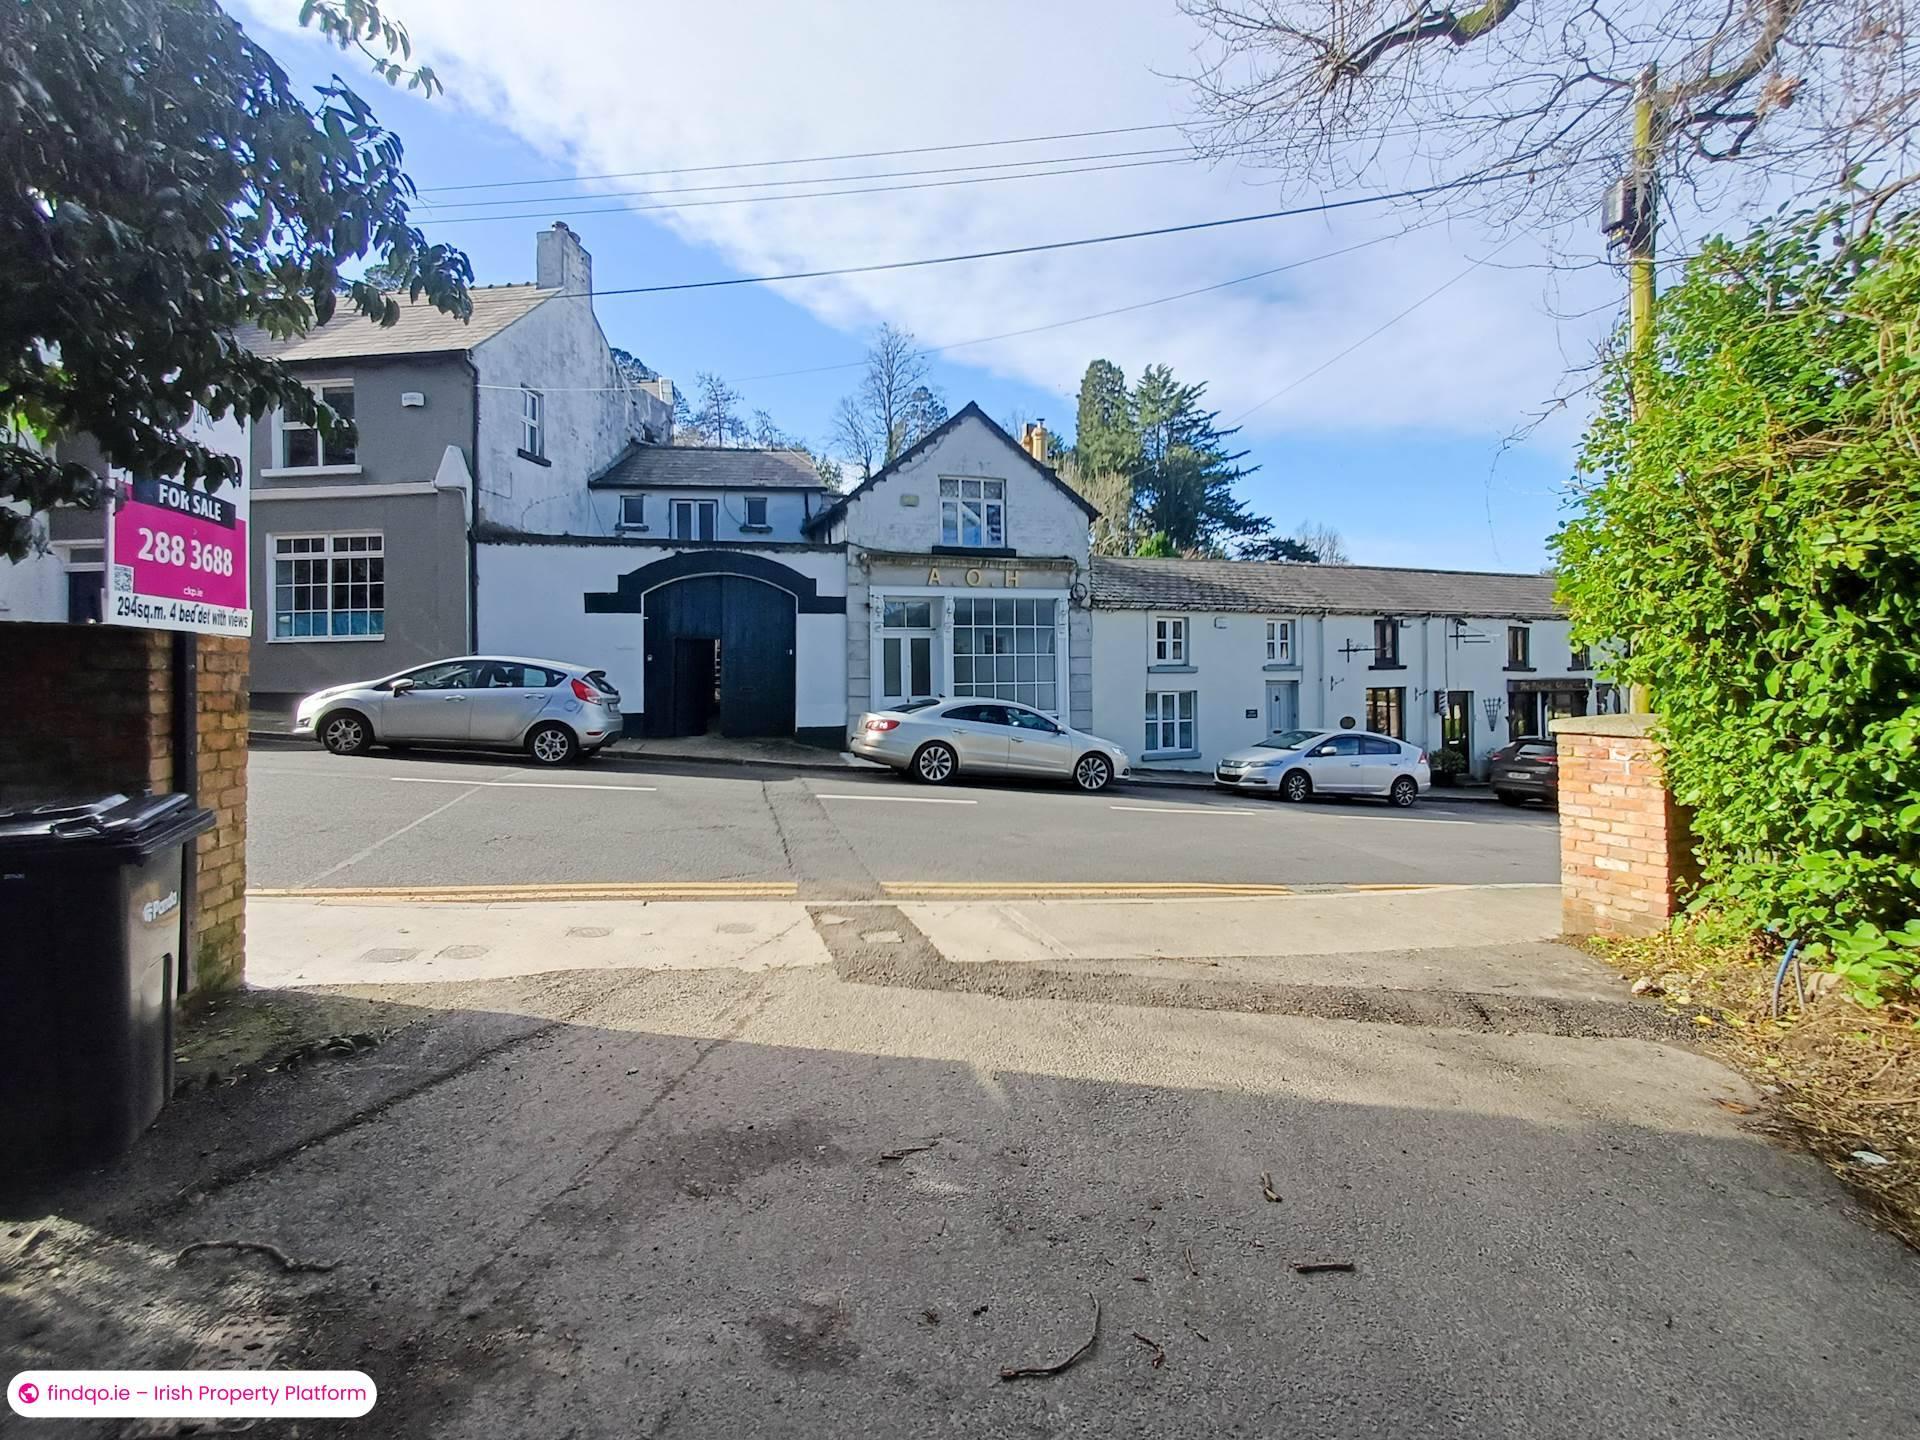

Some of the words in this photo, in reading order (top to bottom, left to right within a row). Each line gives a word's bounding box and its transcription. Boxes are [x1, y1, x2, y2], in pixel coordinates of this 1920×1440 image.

[159, 484, 190, 511] FOR
[192, 495, 222, 521] SALE
[138, 527, 186, 567] 288
[190, 539, 233, 577] 3688
[117, 596, 166, 623] 294sq.m.
[169, 602, 177, 618] 4
[179, 603, 198, 623] bed
[198, 606, 210, 625] det
[212, 610, 227, 626] with
[228, 610, 249, 628] views
